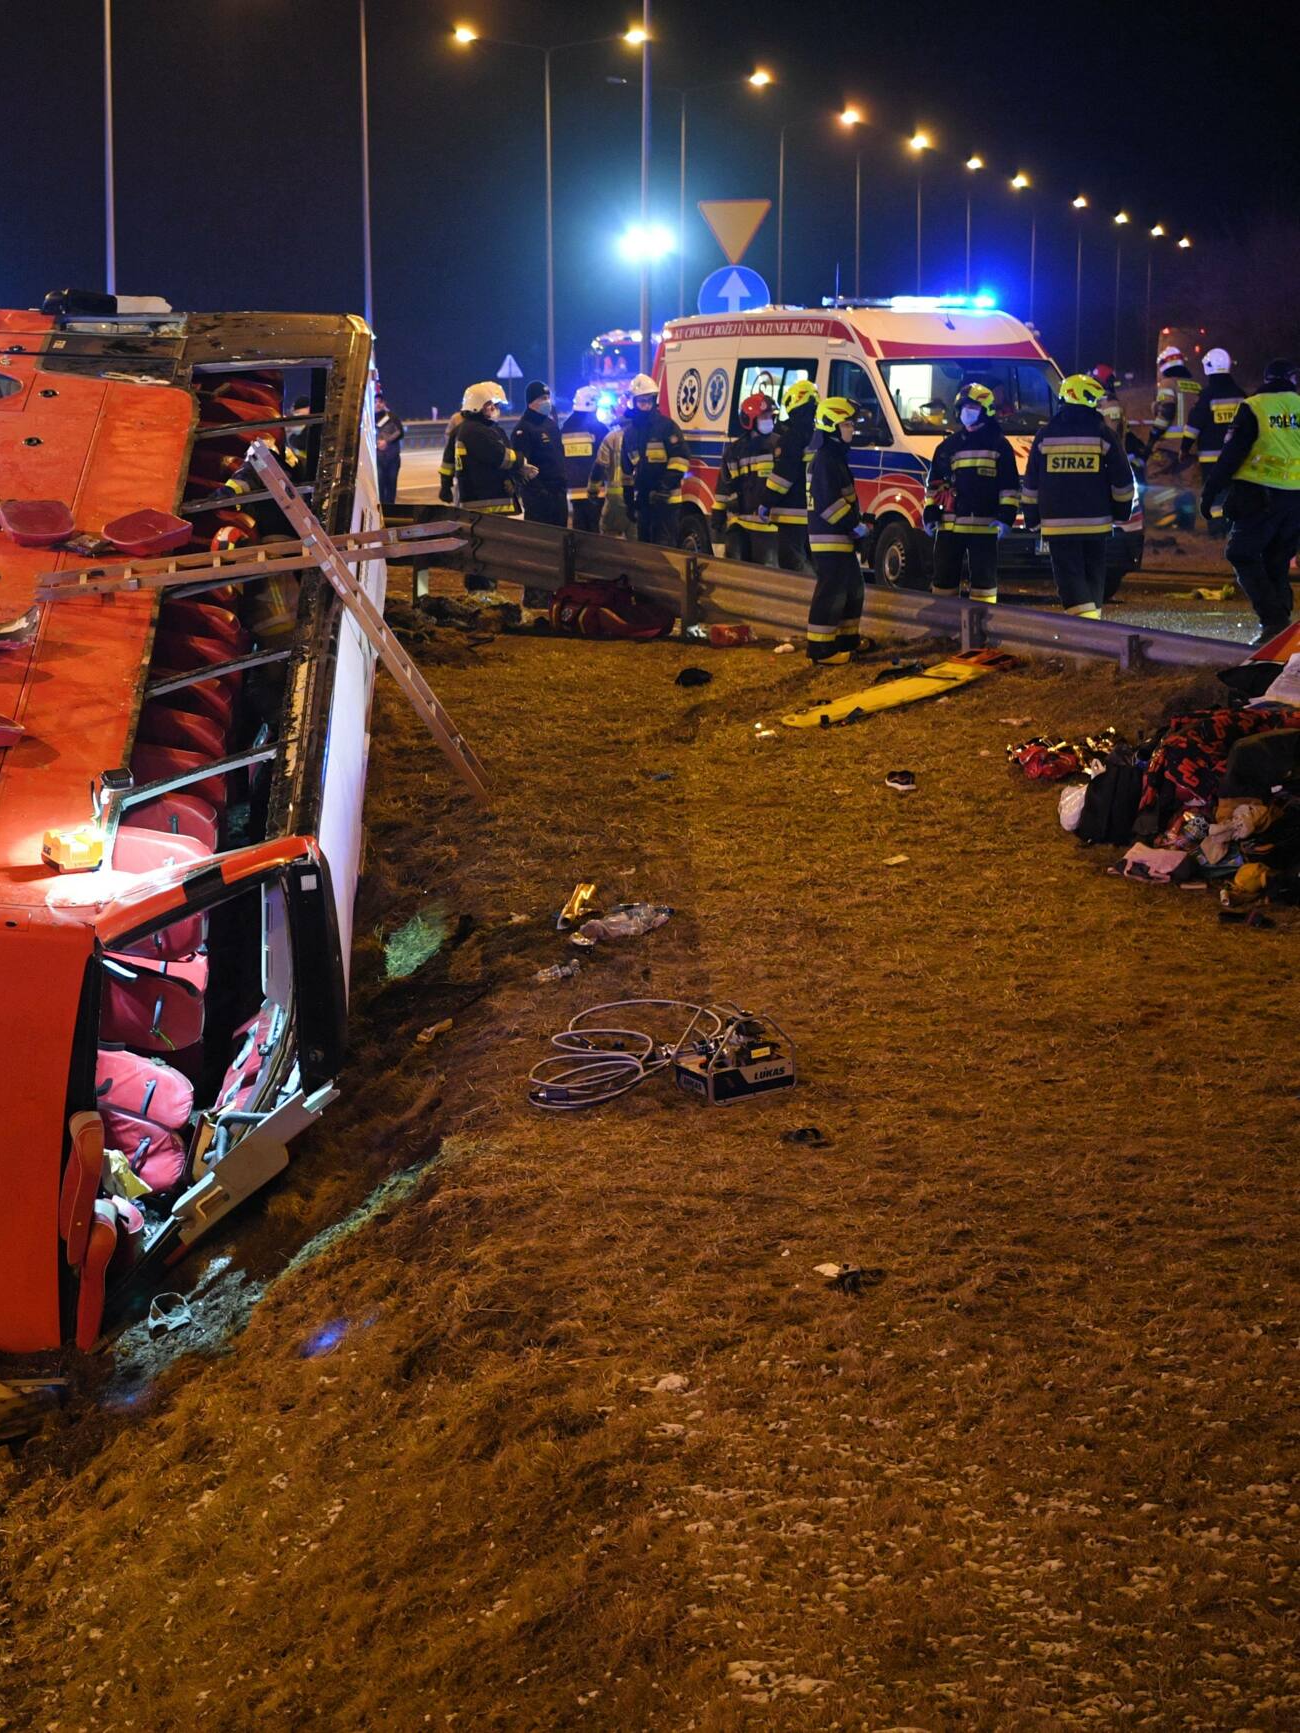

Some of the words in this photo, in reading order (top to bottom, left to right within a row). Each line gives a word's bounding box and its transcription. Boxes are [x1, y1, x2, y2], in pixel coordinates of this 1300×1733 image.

[685, 325, 714, 338] CHWALE
[755, 322, 790, 334] RATUNEK
[754, 1066, 785, 1080] LUKAS
